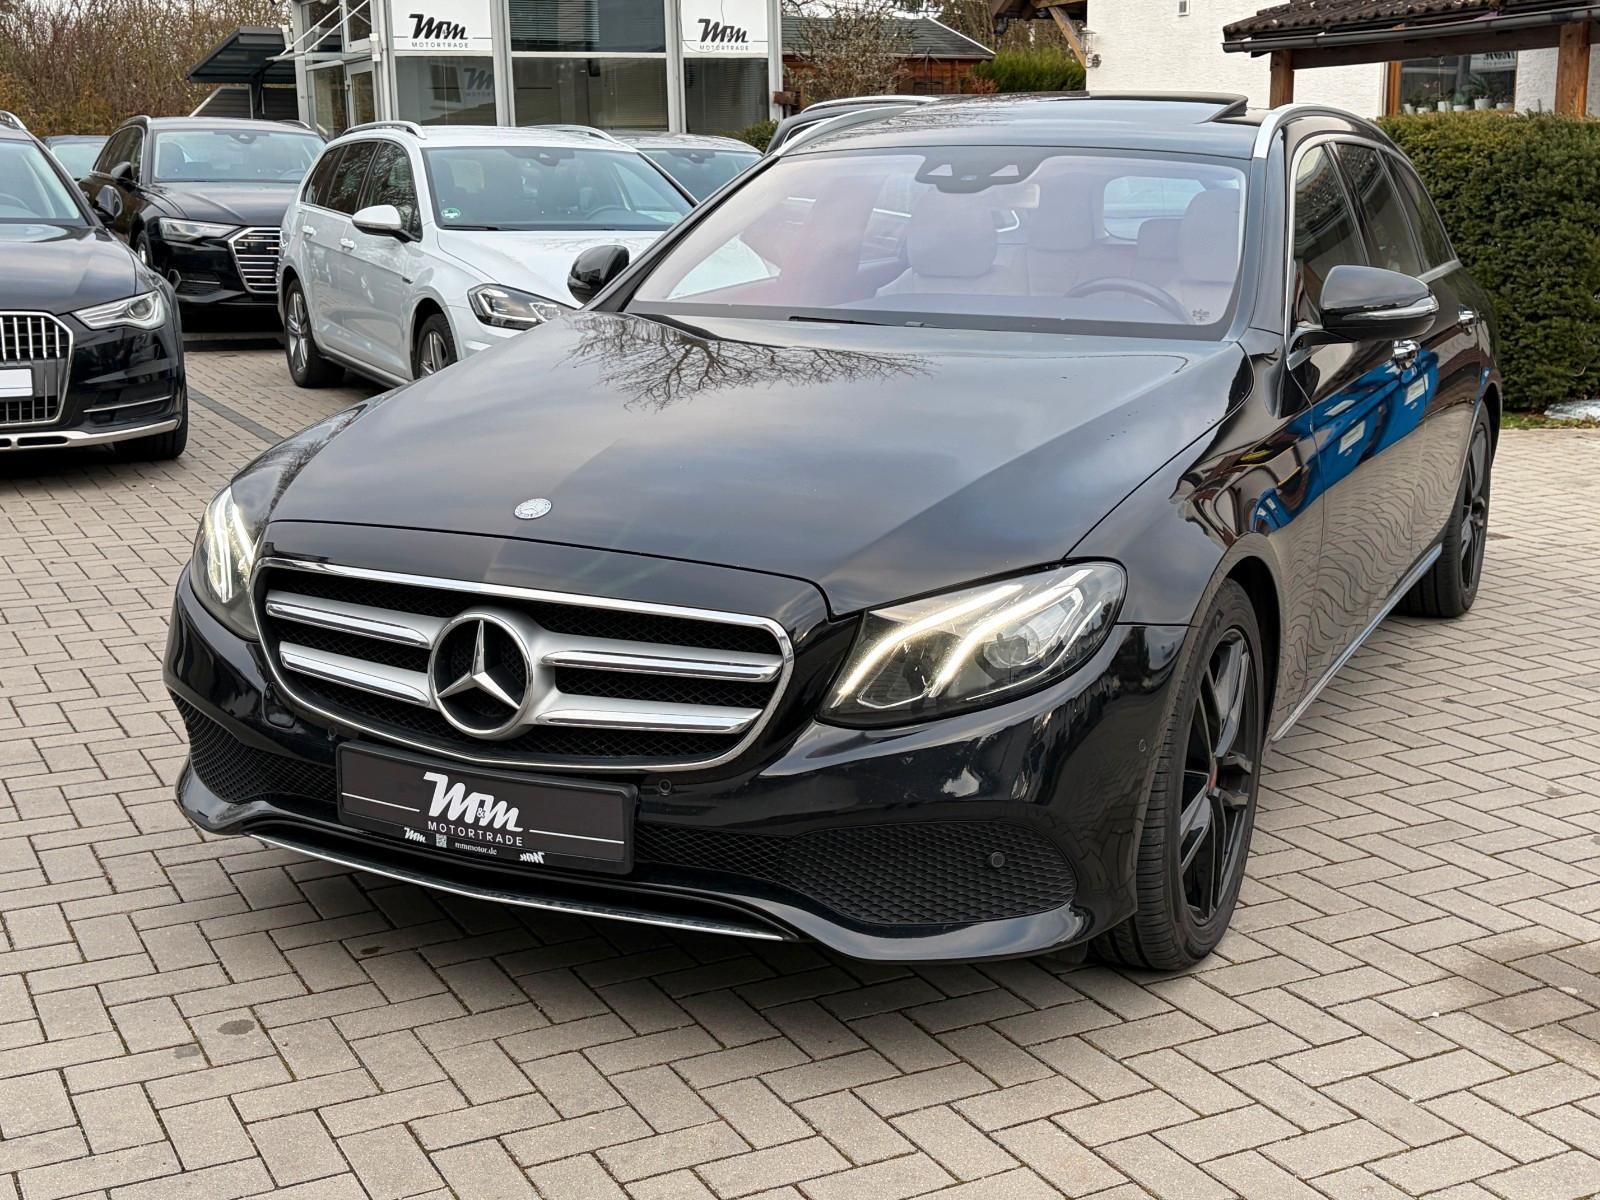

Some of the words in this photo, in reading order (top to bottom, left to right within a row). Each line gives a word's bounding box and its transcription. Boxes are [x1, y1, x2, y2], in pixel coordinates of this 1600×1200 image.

[411, 41, 469, 49] MOTORTRADE
[427, 820, 523, 847] MOTORTRADE
[454, 841, 498, 856] mmmotor.de
